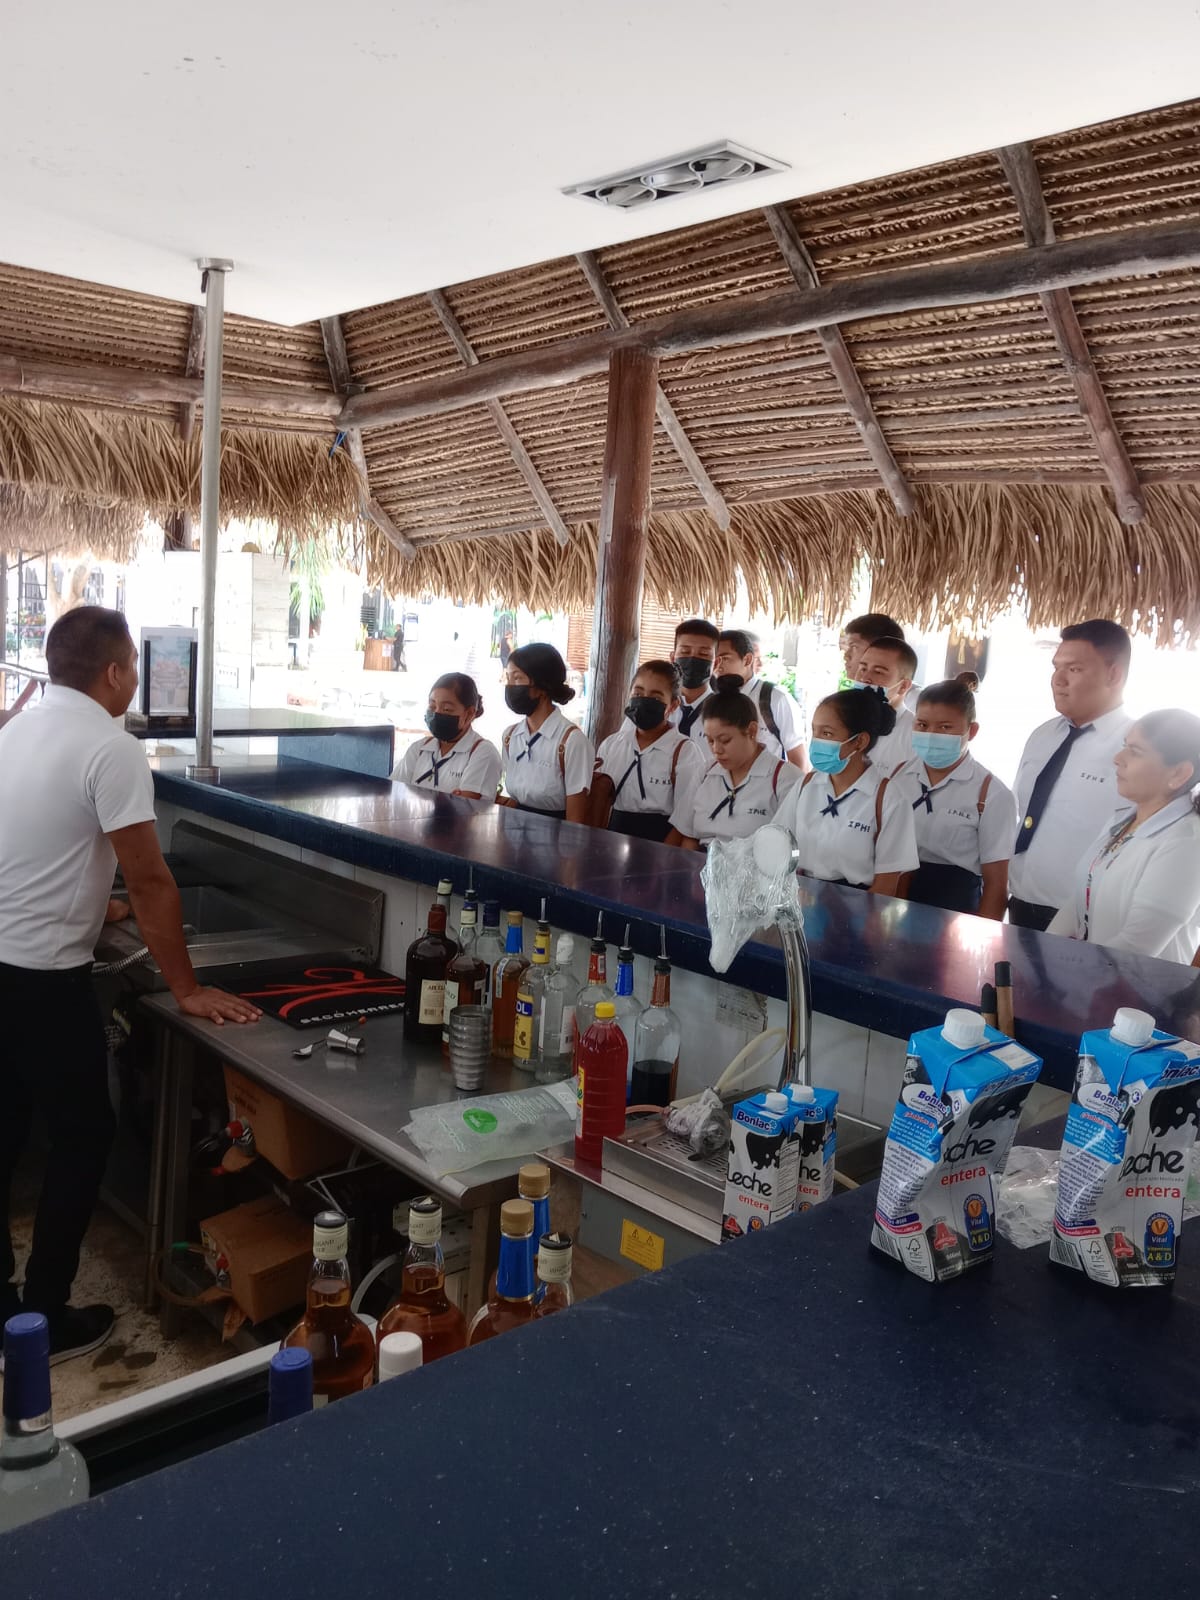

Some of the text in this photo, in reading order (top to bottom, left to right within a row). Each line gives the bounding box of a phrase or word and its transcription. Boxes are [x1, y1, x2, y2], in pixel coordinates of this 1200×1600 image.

[736, 1110, 771, 1131] Bonlac
[726, 1164, 772, 1197] Leche
[941, 1166, 986, 1186] entera
[798, 1183, 819, 1196] tera
[1125, 1184, 1181, 1198] entera
[738, 1194, 769, 1211] entera
[1147, 1253, 1154, 1261] A
[1165, 1253, 1172, 1261] D
